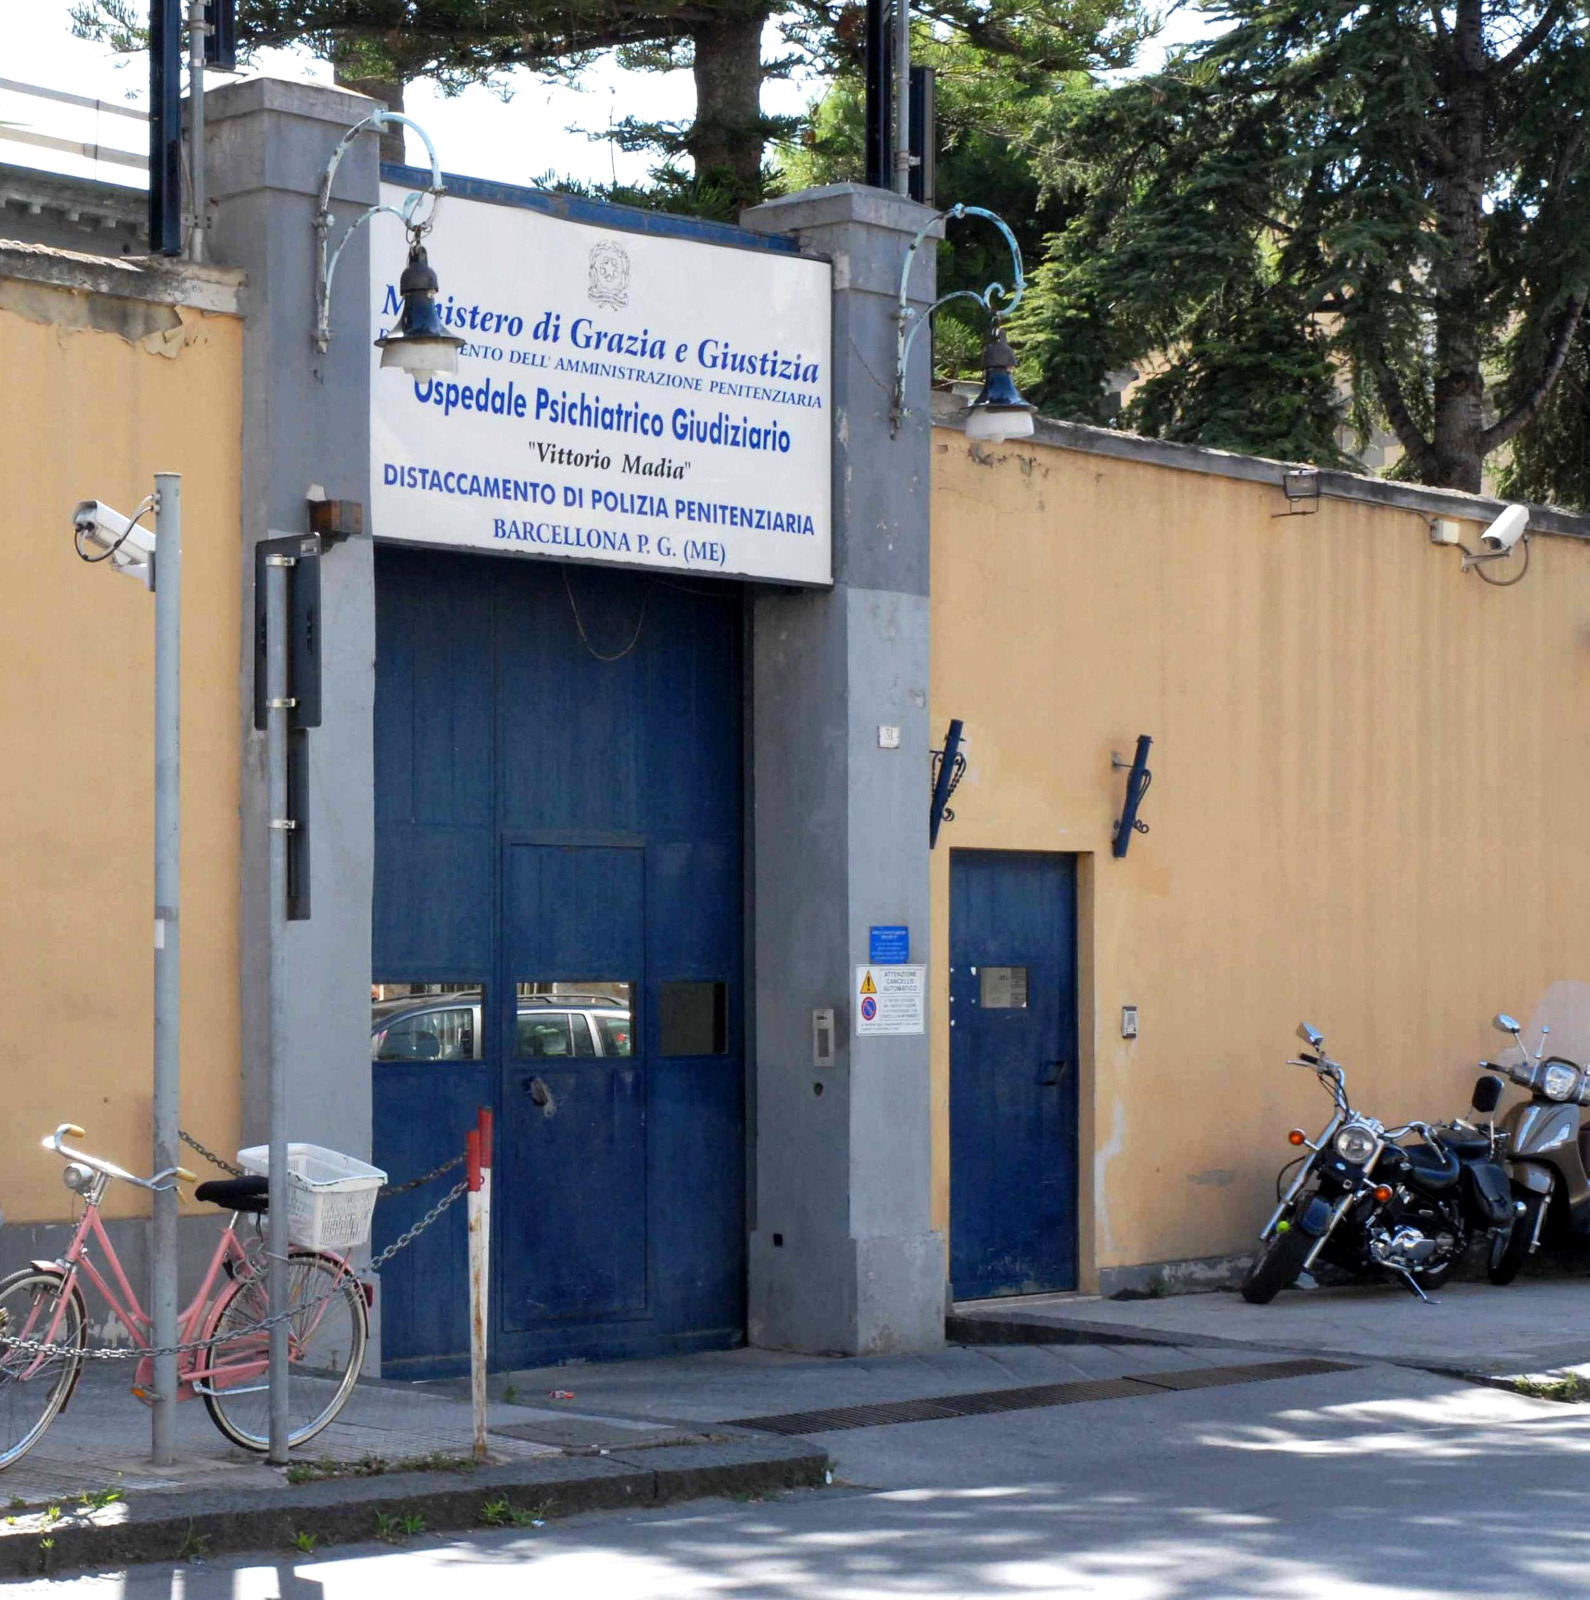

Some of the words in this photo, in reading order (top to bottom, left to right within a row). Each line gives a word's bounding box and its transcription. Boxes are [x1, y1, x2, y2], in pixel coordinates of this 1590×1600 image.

[509, 350, 551, 368] DELL'
[554, 357, 703, 391] AMMINISTRAZIONE
[709, 381, 822, 409] PENITENZIARIA
[533, 312, 560, 343] di
[571, 318, 665, 360] Grazia
[675, 343, 688, 363] e
[698, 339, 819, 383] Giustizia
[414, 377, 527, 418] Ospedale
[535, 388, 663, 437] Psichiatrico
[672, 408, 790, 453] Giudiziario
[529, 441, 611, 470] "Vittorio
[621, 453, 691, 480] Madia"
[384, 463, 556, 505] DISTACCAMENTO
[564, 486, 583, 508] DI
[592, 489, 669, 518] POLIZIA
[675, 499, 815, 536] PENITENZIARIA
[493, 518, 631, 552] BARCELLONA
[637, 534, 650, 554] P.
[657, 536, 676, 557] G.
[683, 539, 726, 567] (ME)
